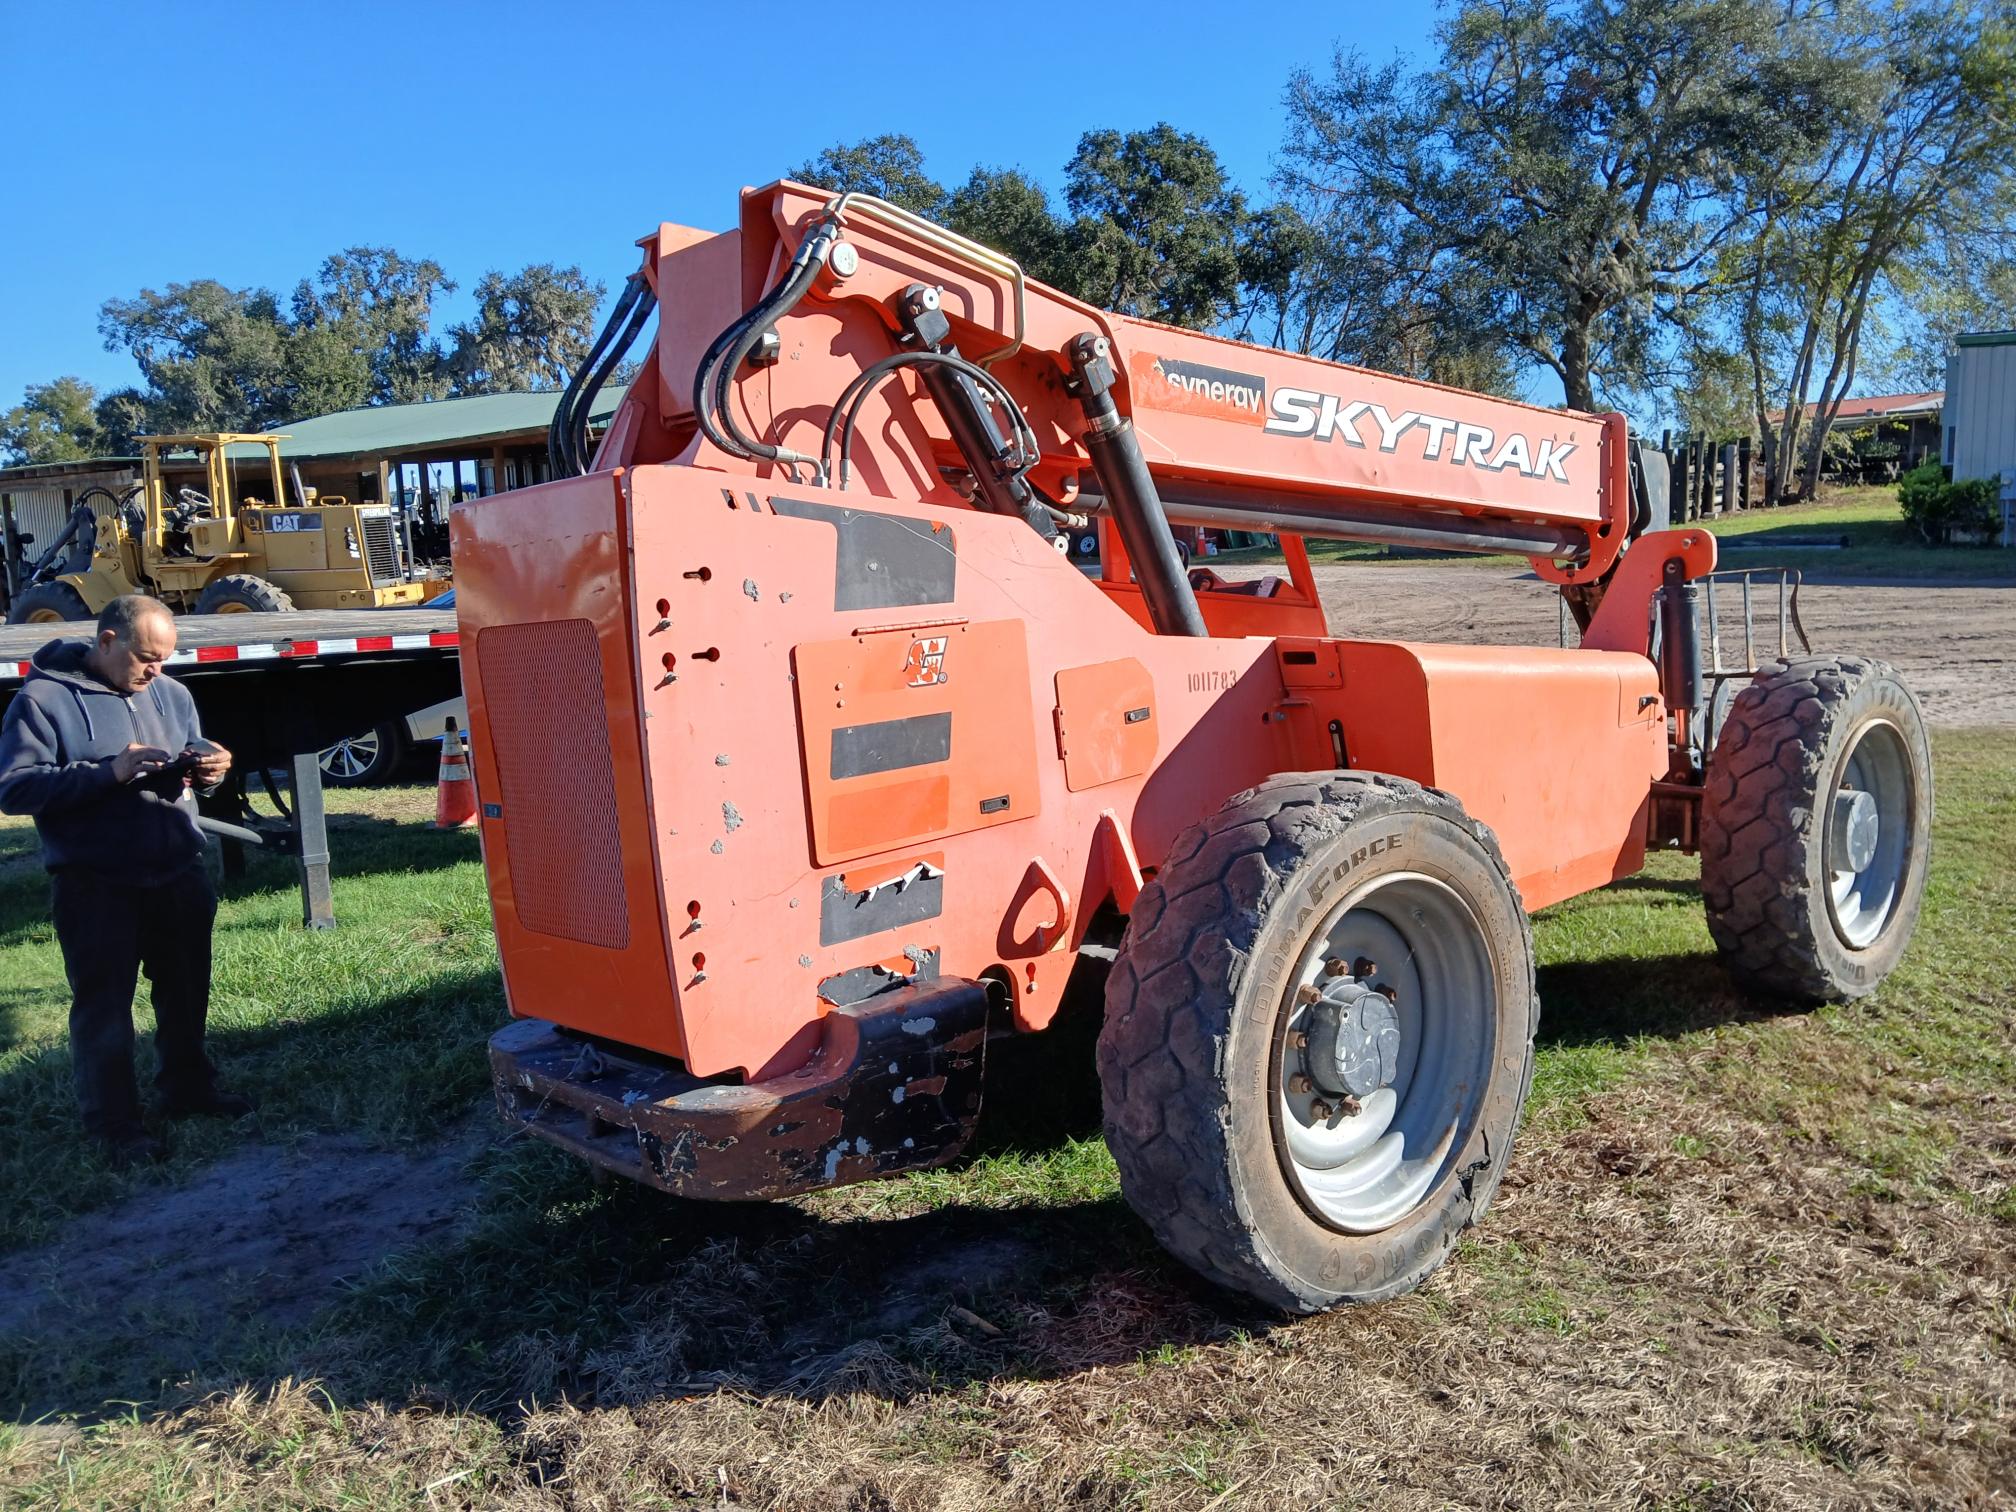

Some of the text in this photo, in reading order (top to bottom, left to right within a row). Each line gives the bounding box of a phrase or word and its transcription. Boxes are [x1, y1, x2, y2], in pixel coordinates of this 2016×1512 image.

[1263, 387, 1578, 483] SKYTRAK
[272, 515, 300, 532] CAT
[1187, 669, 1237, 693] 1011783
